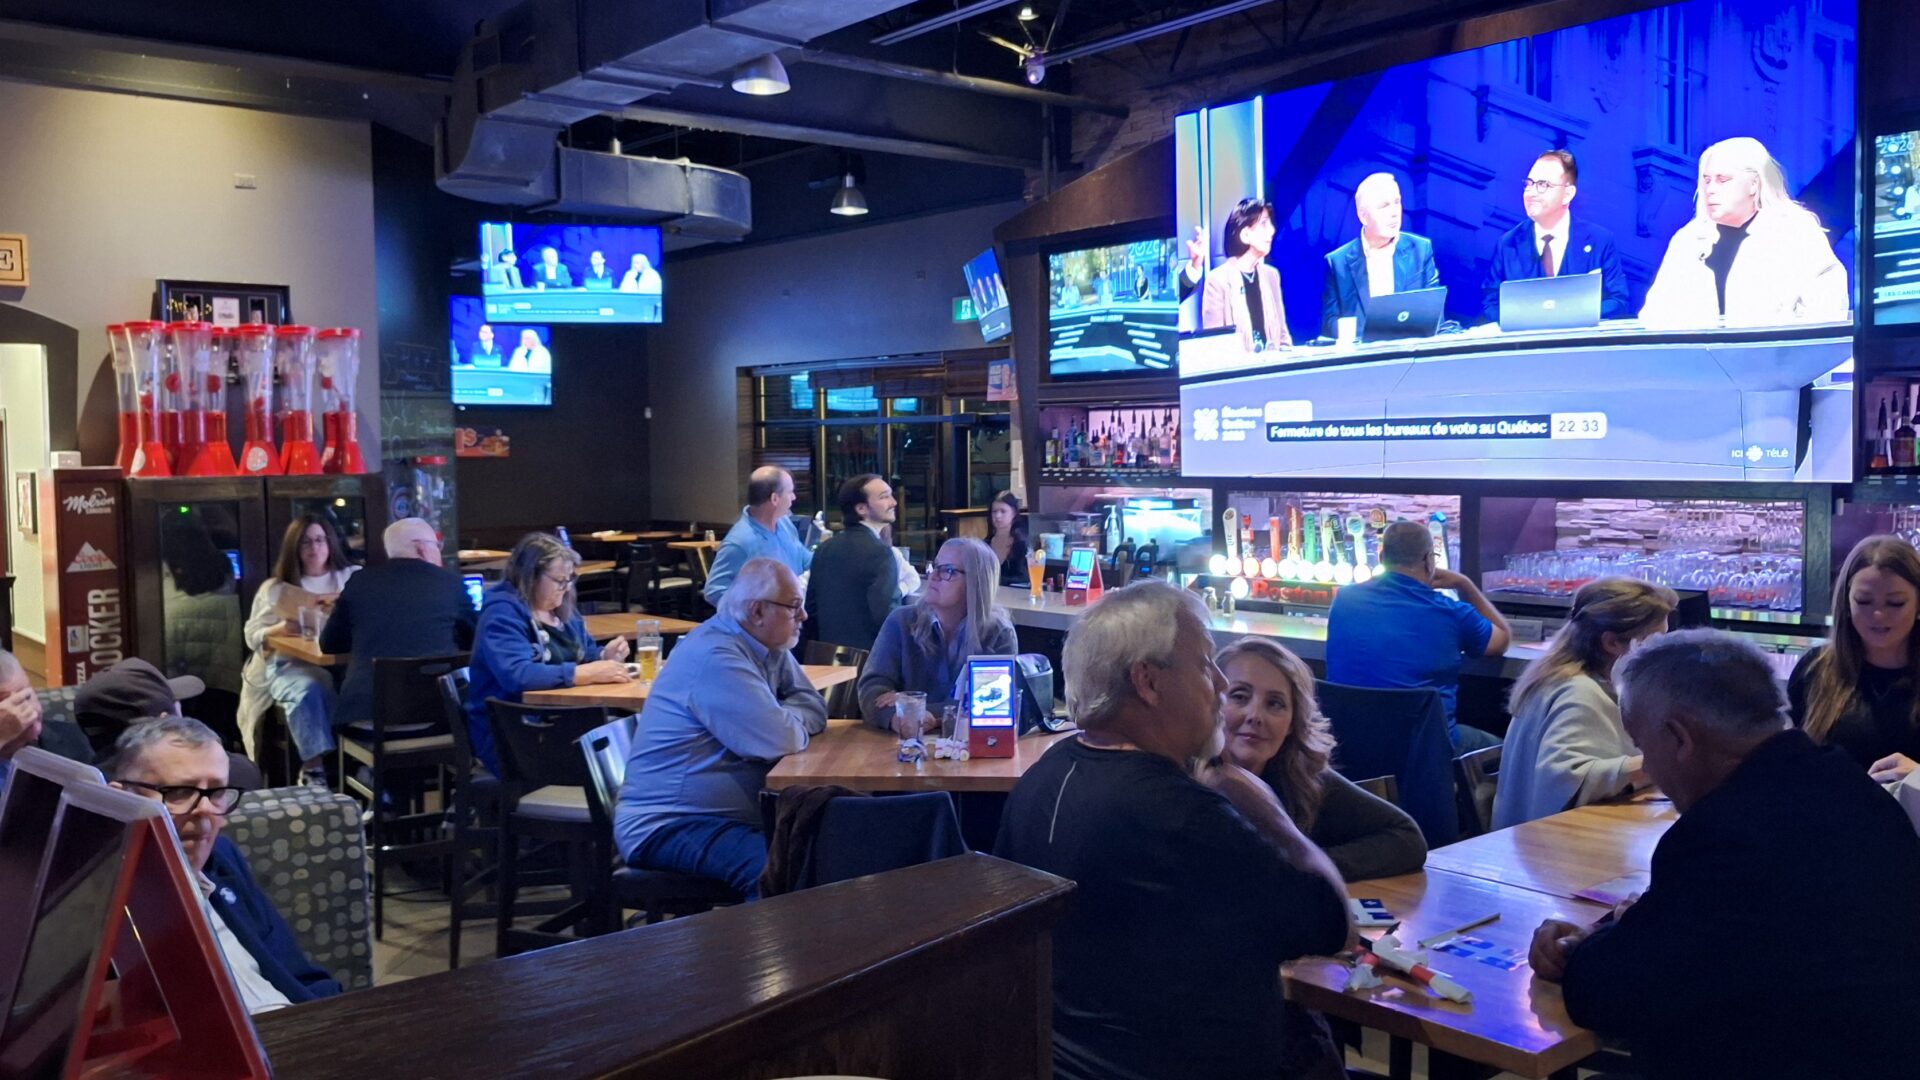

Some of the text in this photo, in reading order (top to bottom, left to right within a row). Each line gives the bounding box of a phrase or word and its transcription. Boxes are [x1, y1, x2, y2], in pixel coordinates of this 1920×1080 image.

[1270, 420, 1548, 439] Fermeture de tous les bureaux de vote au Québec
[1558, 419, 1599, 432] 22 33
[1731, 449, 1744, 458] ICI
[87, 588, 123, 678] OCKER
